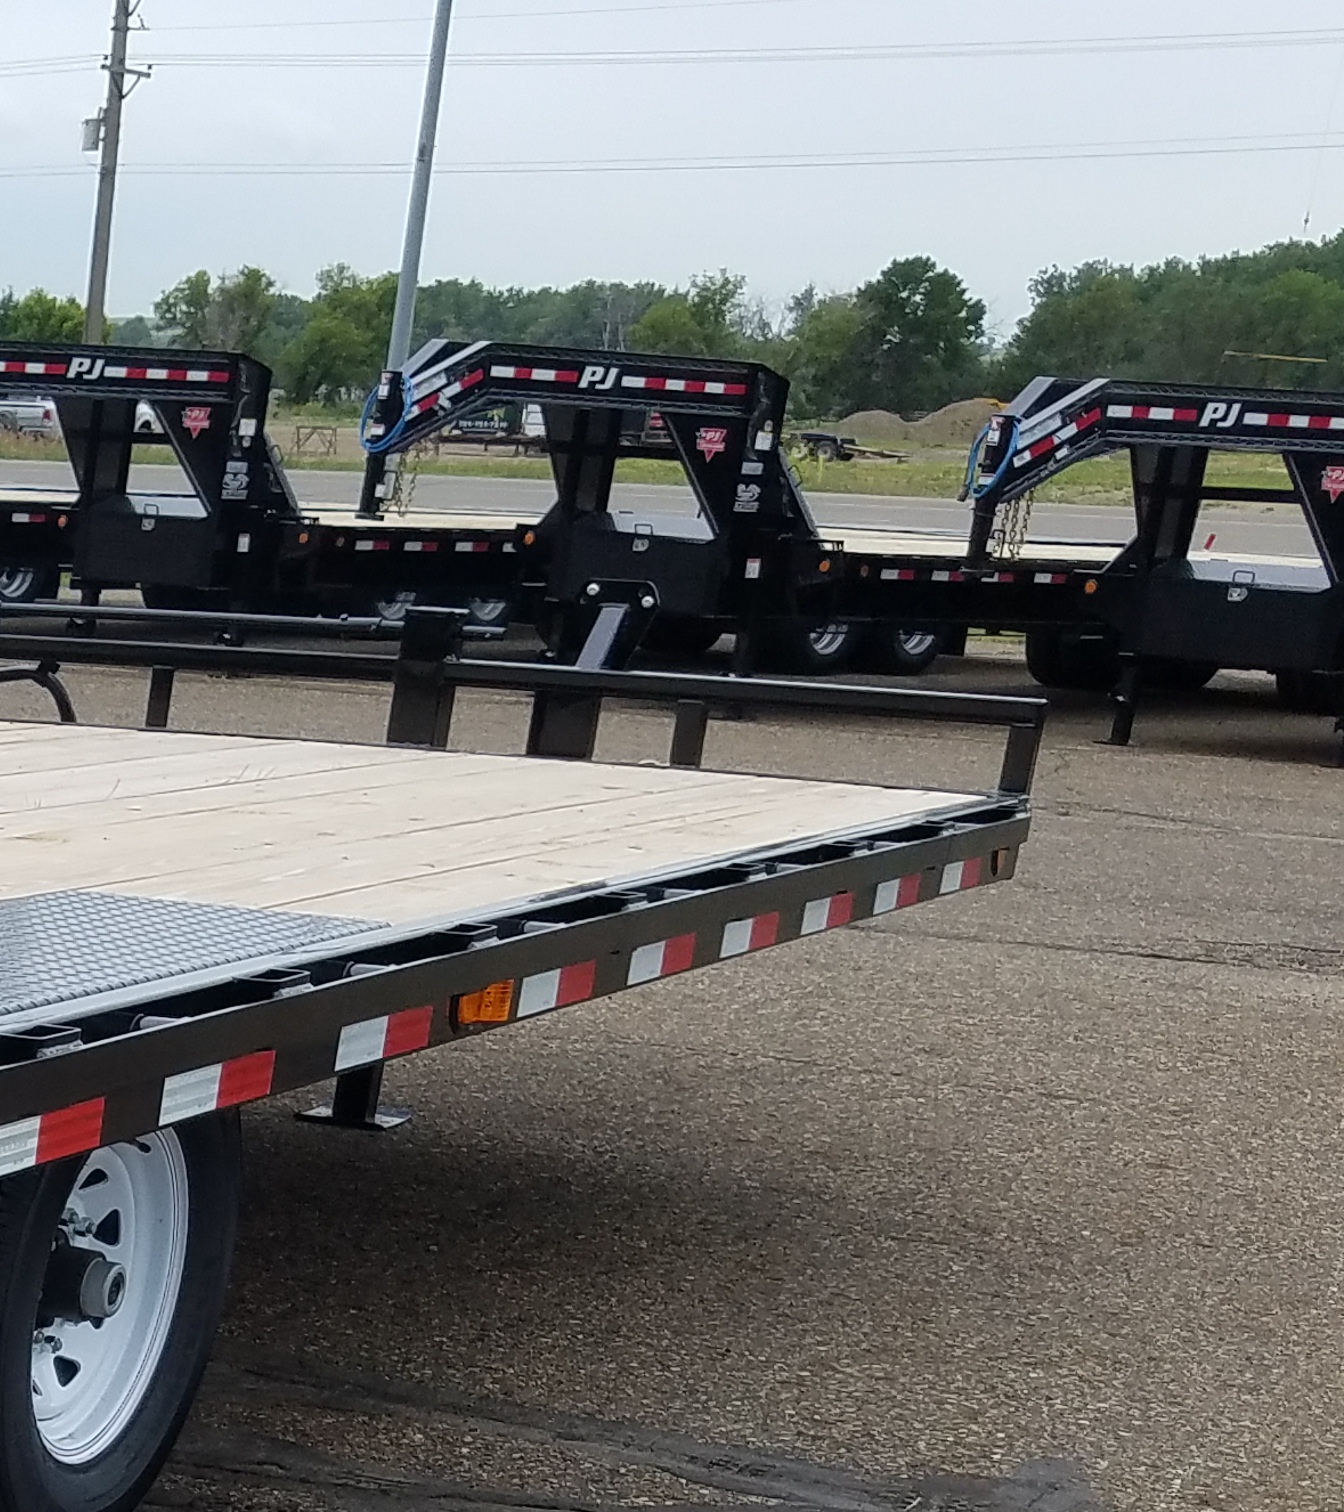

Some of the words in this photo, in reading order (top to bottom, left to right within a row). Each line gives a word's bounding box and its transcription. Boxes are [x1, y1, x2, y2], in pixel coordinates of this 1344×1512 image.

[66, 357, 106, 380] PJ
[578, 365, 620, 390] PJ
[1198, 402, 1242, 428] PJ
